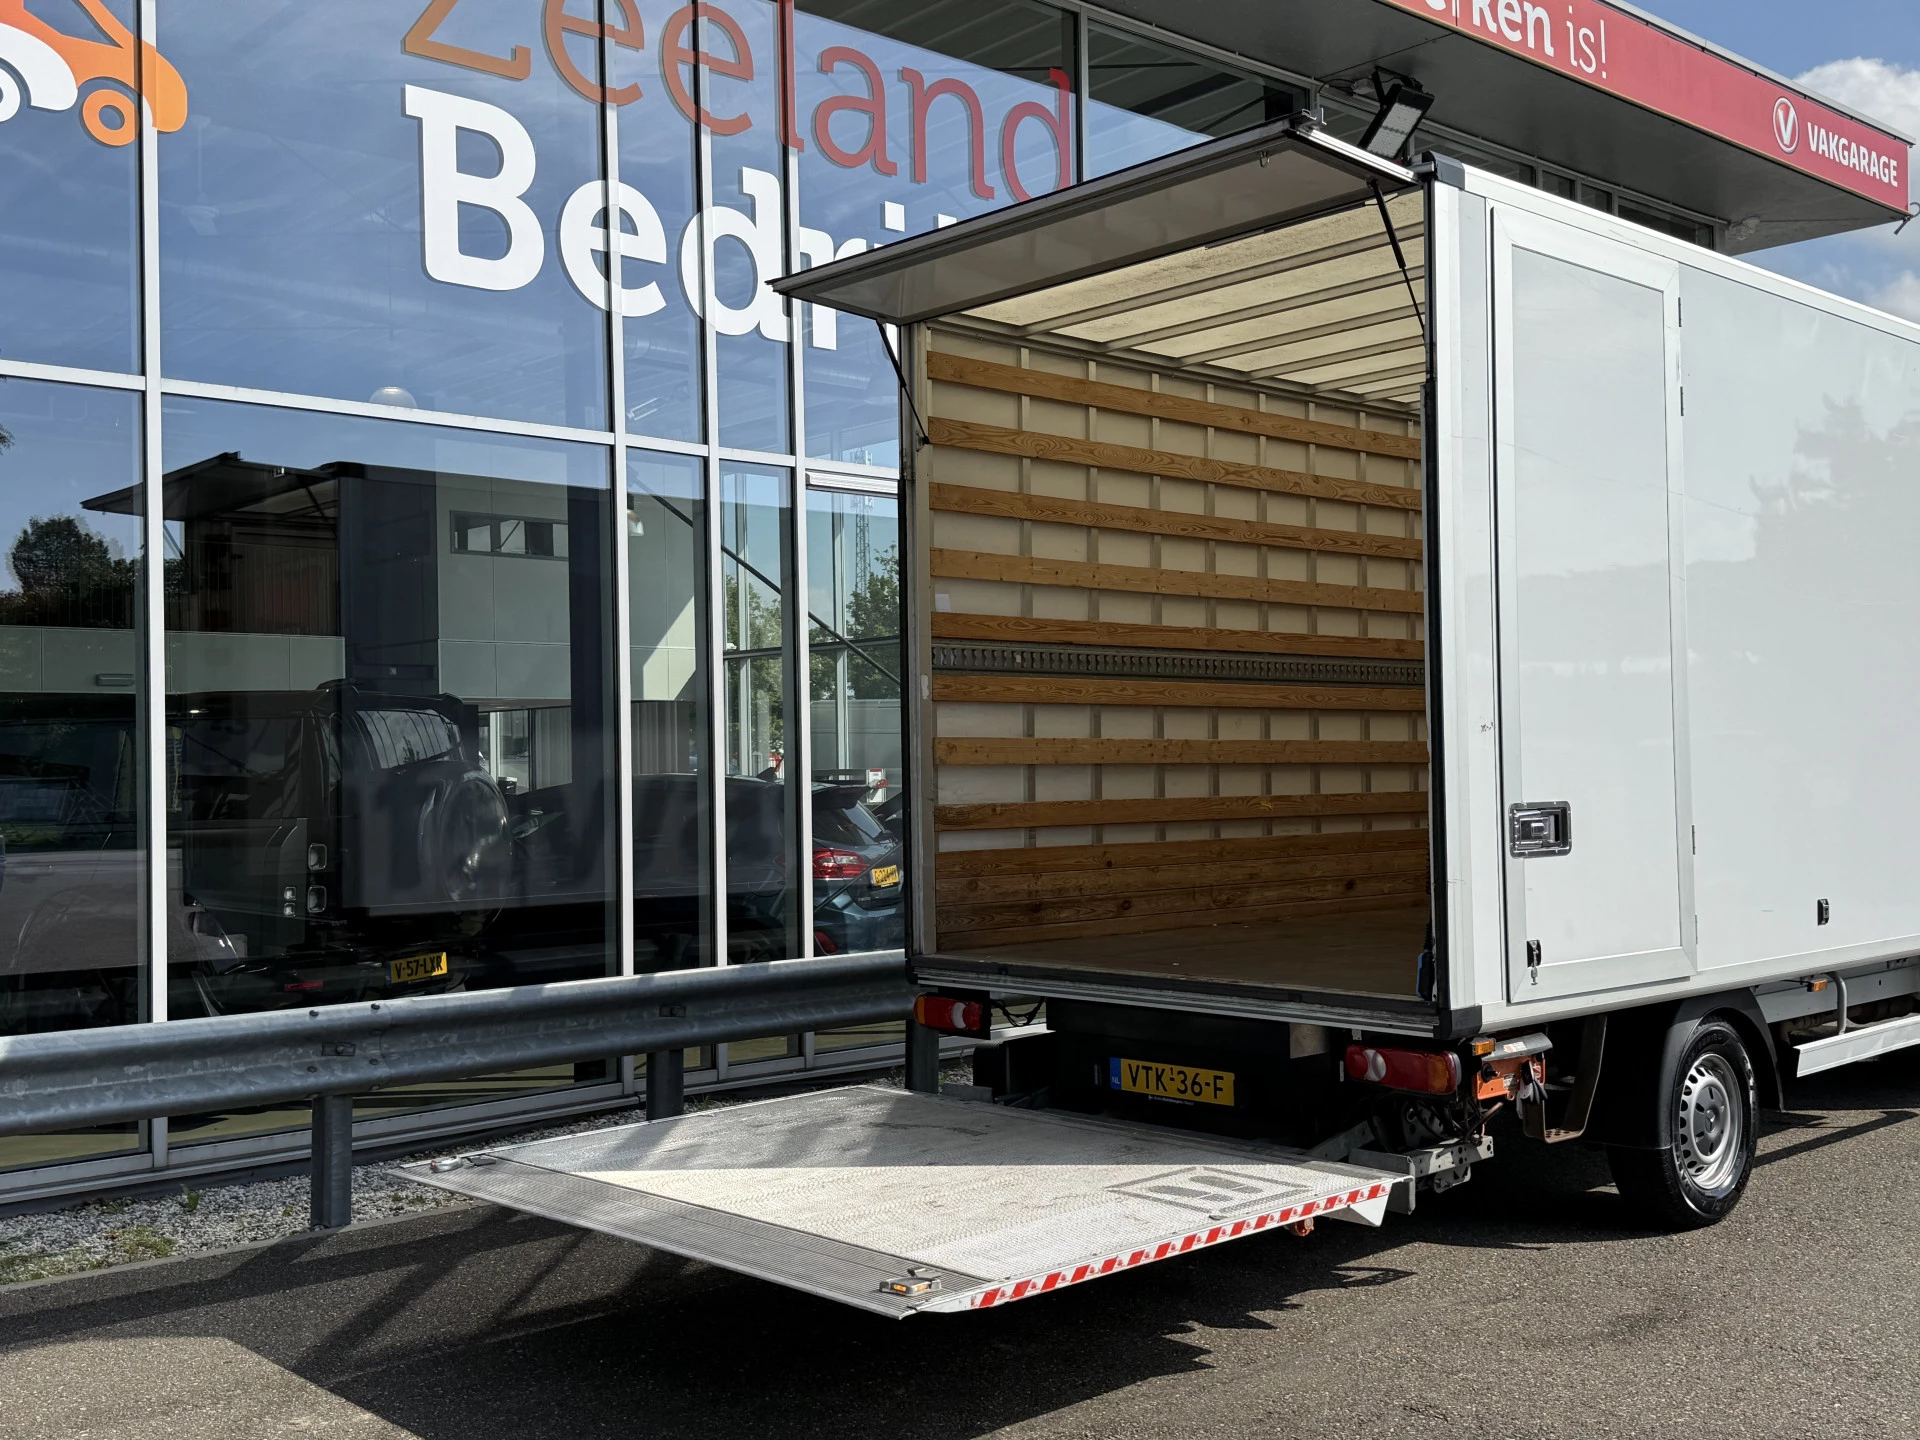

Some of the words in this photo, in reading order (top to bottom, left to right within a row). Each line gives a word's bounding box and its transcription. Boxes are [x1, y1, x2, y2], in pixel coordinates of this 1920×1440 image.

[1567, 5, 1608, 79] is!
[1807, 121, 1899, 188] VAKGARAGE
[395, 955, 443, 979] V-57-LXR
[1111, 1076, 1121, 1085] NL
[1128, 1063, 1225, 1100] VTK-36-F
